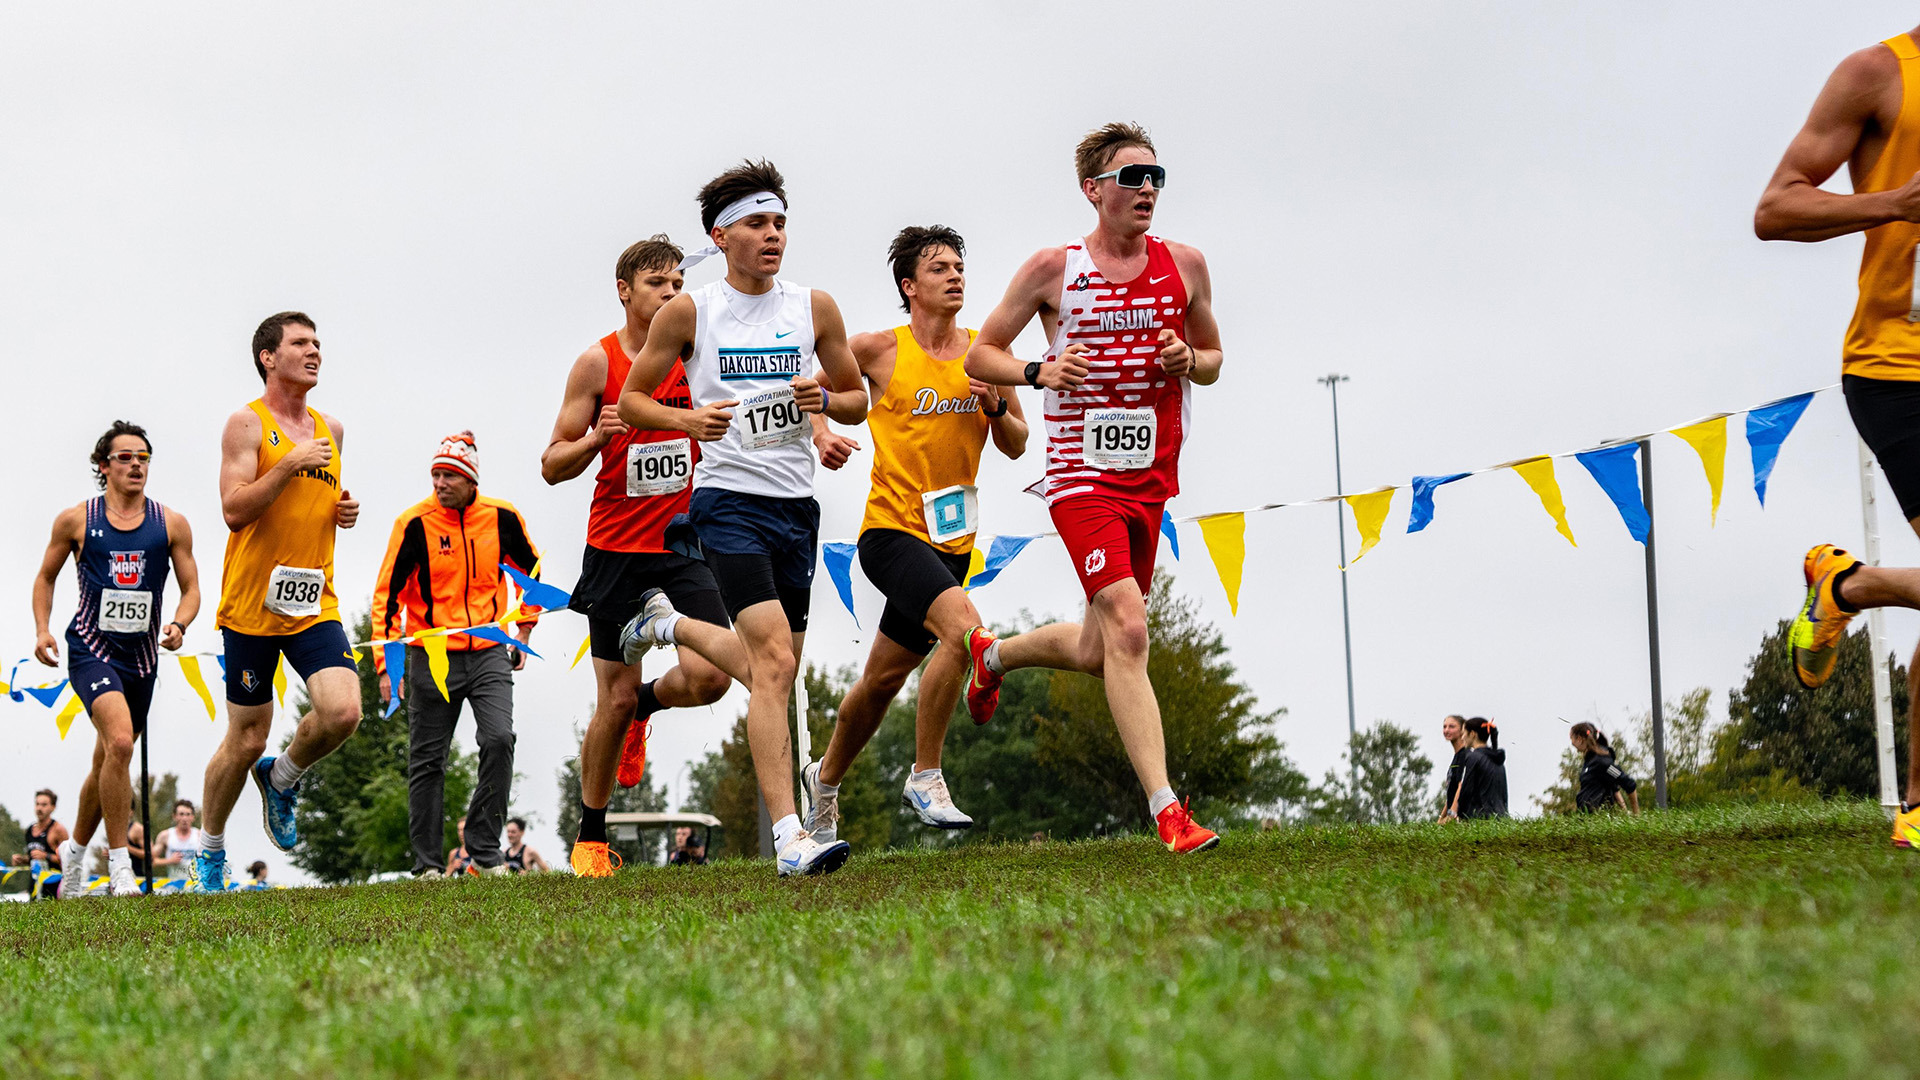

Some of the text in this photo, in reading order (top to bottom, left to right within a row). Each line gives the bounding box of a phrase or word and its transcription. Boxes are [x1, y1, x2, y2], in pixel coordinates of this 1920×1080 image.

[1099, 308, 1154, 331] MSUM
[719, 354, 801, 374] DAKOTA STATE
[911, 387, 980, 417] Dordt
[744, 399, 803, 435] 1790
[1093, 413, 1151, 421] DAKOTATIMING
[635, 442, 684, 455] DAKOTATIMING
[1091, 425, 1151, 451] 1959
[633, 454, 688, 481] 1905
[439, 535, 451, 549] M
[111, 560, 144, 574] MARY
[275, 579, 320, 603] 1938
[105, 601, 147, 620] 2153
